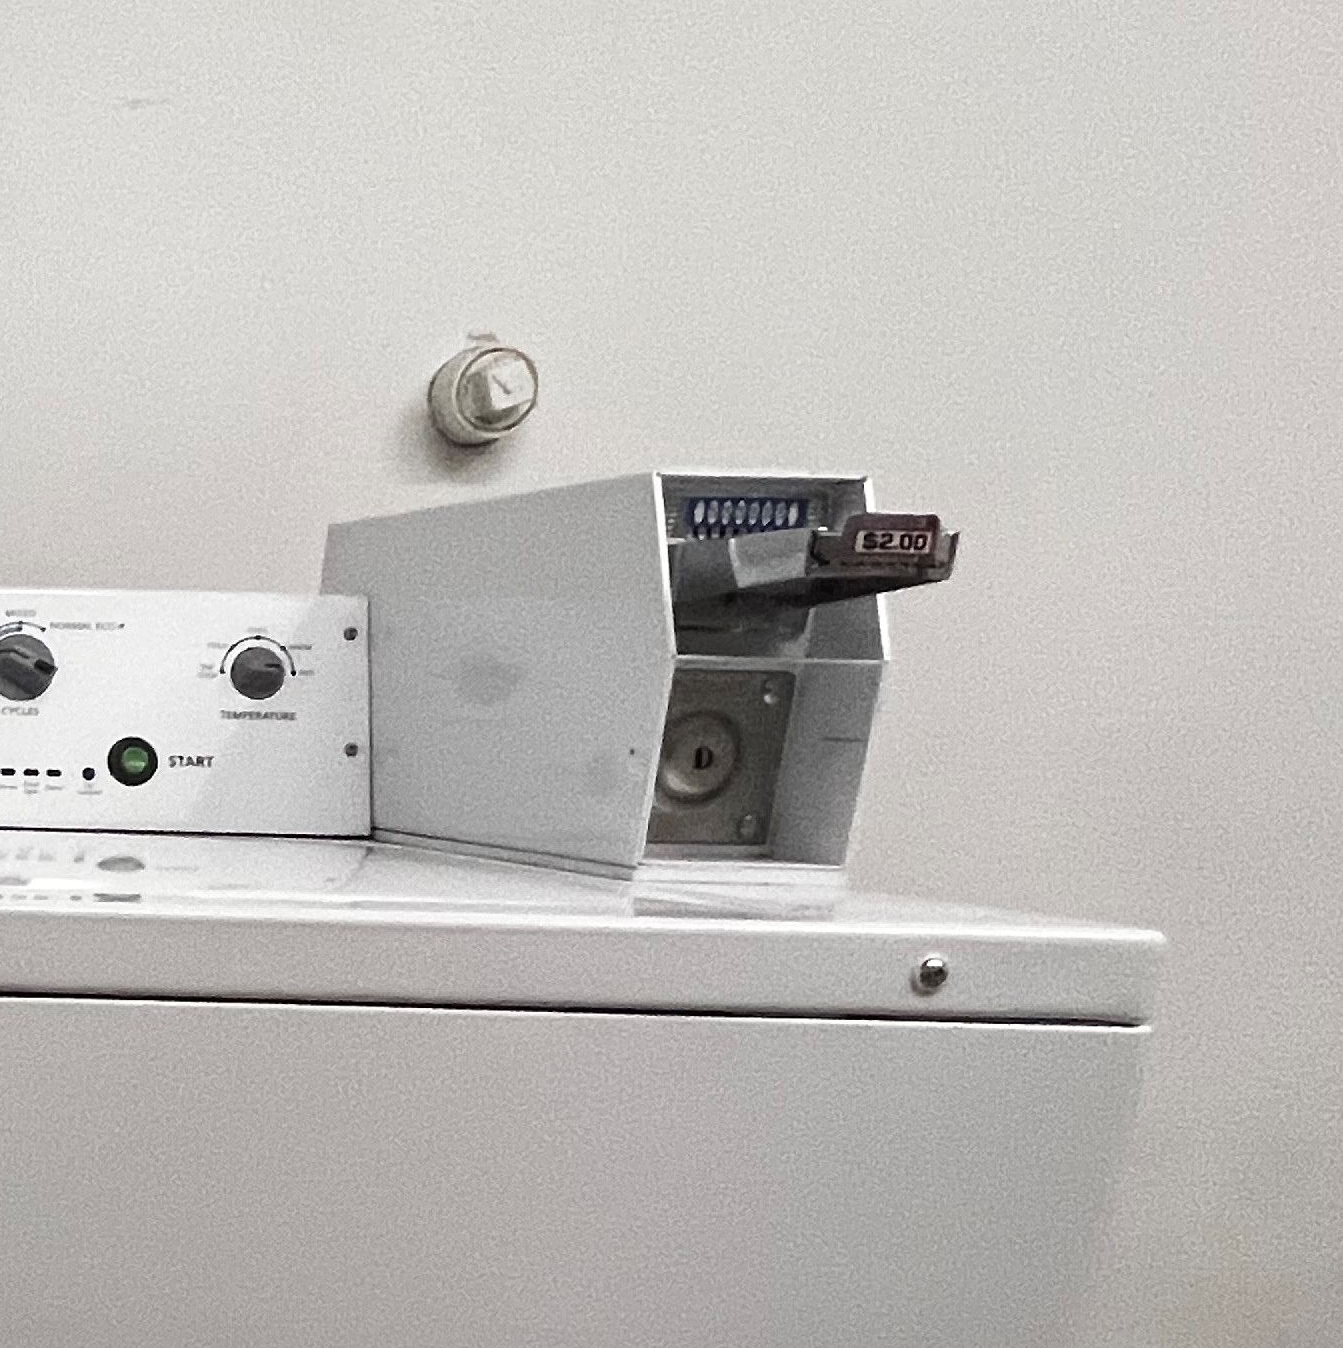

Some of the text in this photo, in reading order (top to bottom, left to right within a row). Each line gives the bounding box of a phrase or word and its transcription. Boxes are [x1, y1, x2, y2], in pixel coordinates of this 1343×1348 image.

[862, 532, 928, 551] $2.00
[1, 706, 40, 717] CYCLES
[219, 709, 298, 721] TEMPERATURE
[167, 754, 215, 768] START
